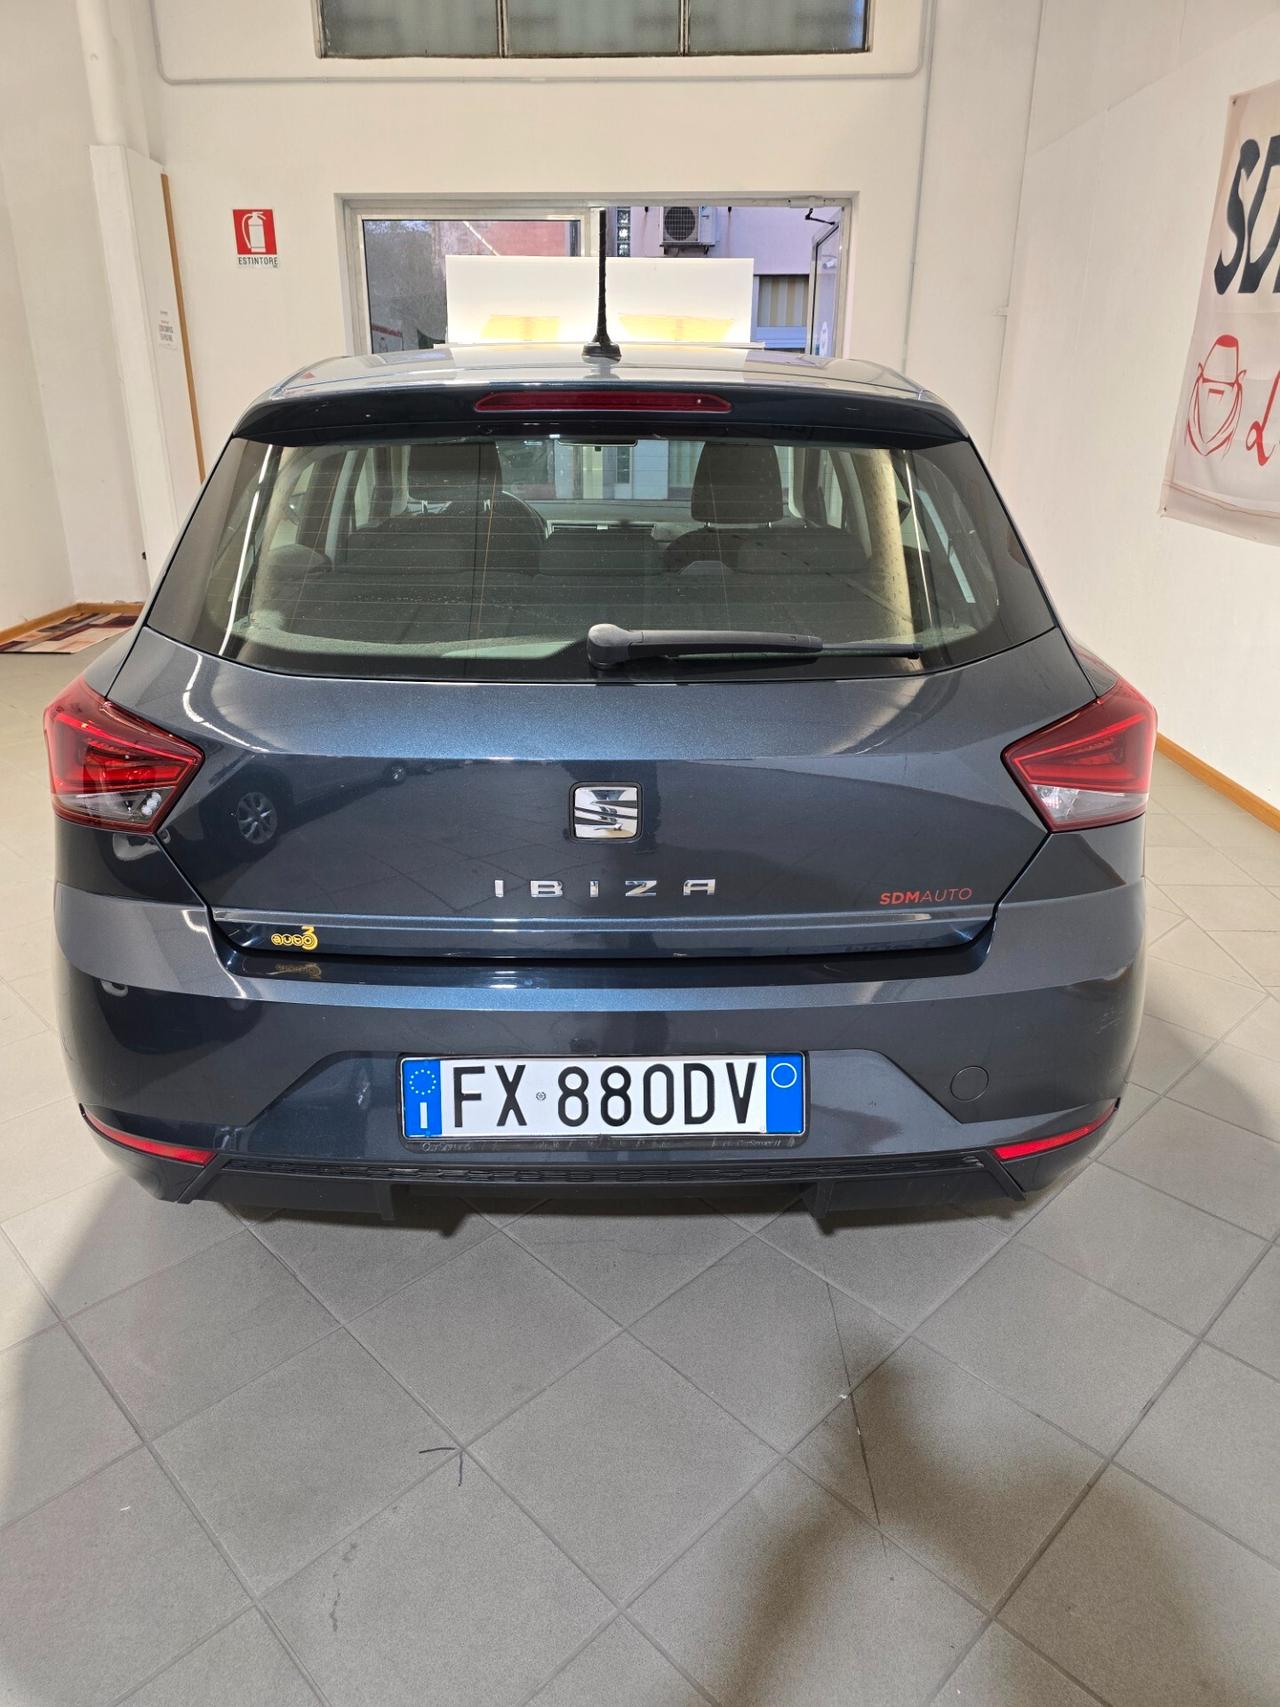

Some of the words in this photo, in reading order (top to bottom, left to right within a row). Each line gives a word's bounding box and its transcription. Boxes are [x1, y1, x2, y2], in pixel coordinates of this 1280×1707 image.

[1214, 134, 1280, 295] SD
[238, 256, 278, 265] ESTINTORE
[494, 878, 717, 898] IBIZA
[879, 887, 973, 905] SDMAUTO
[452, 1064, 528, 1128] FX
[557, 1062, 758, 1127] 880DV
